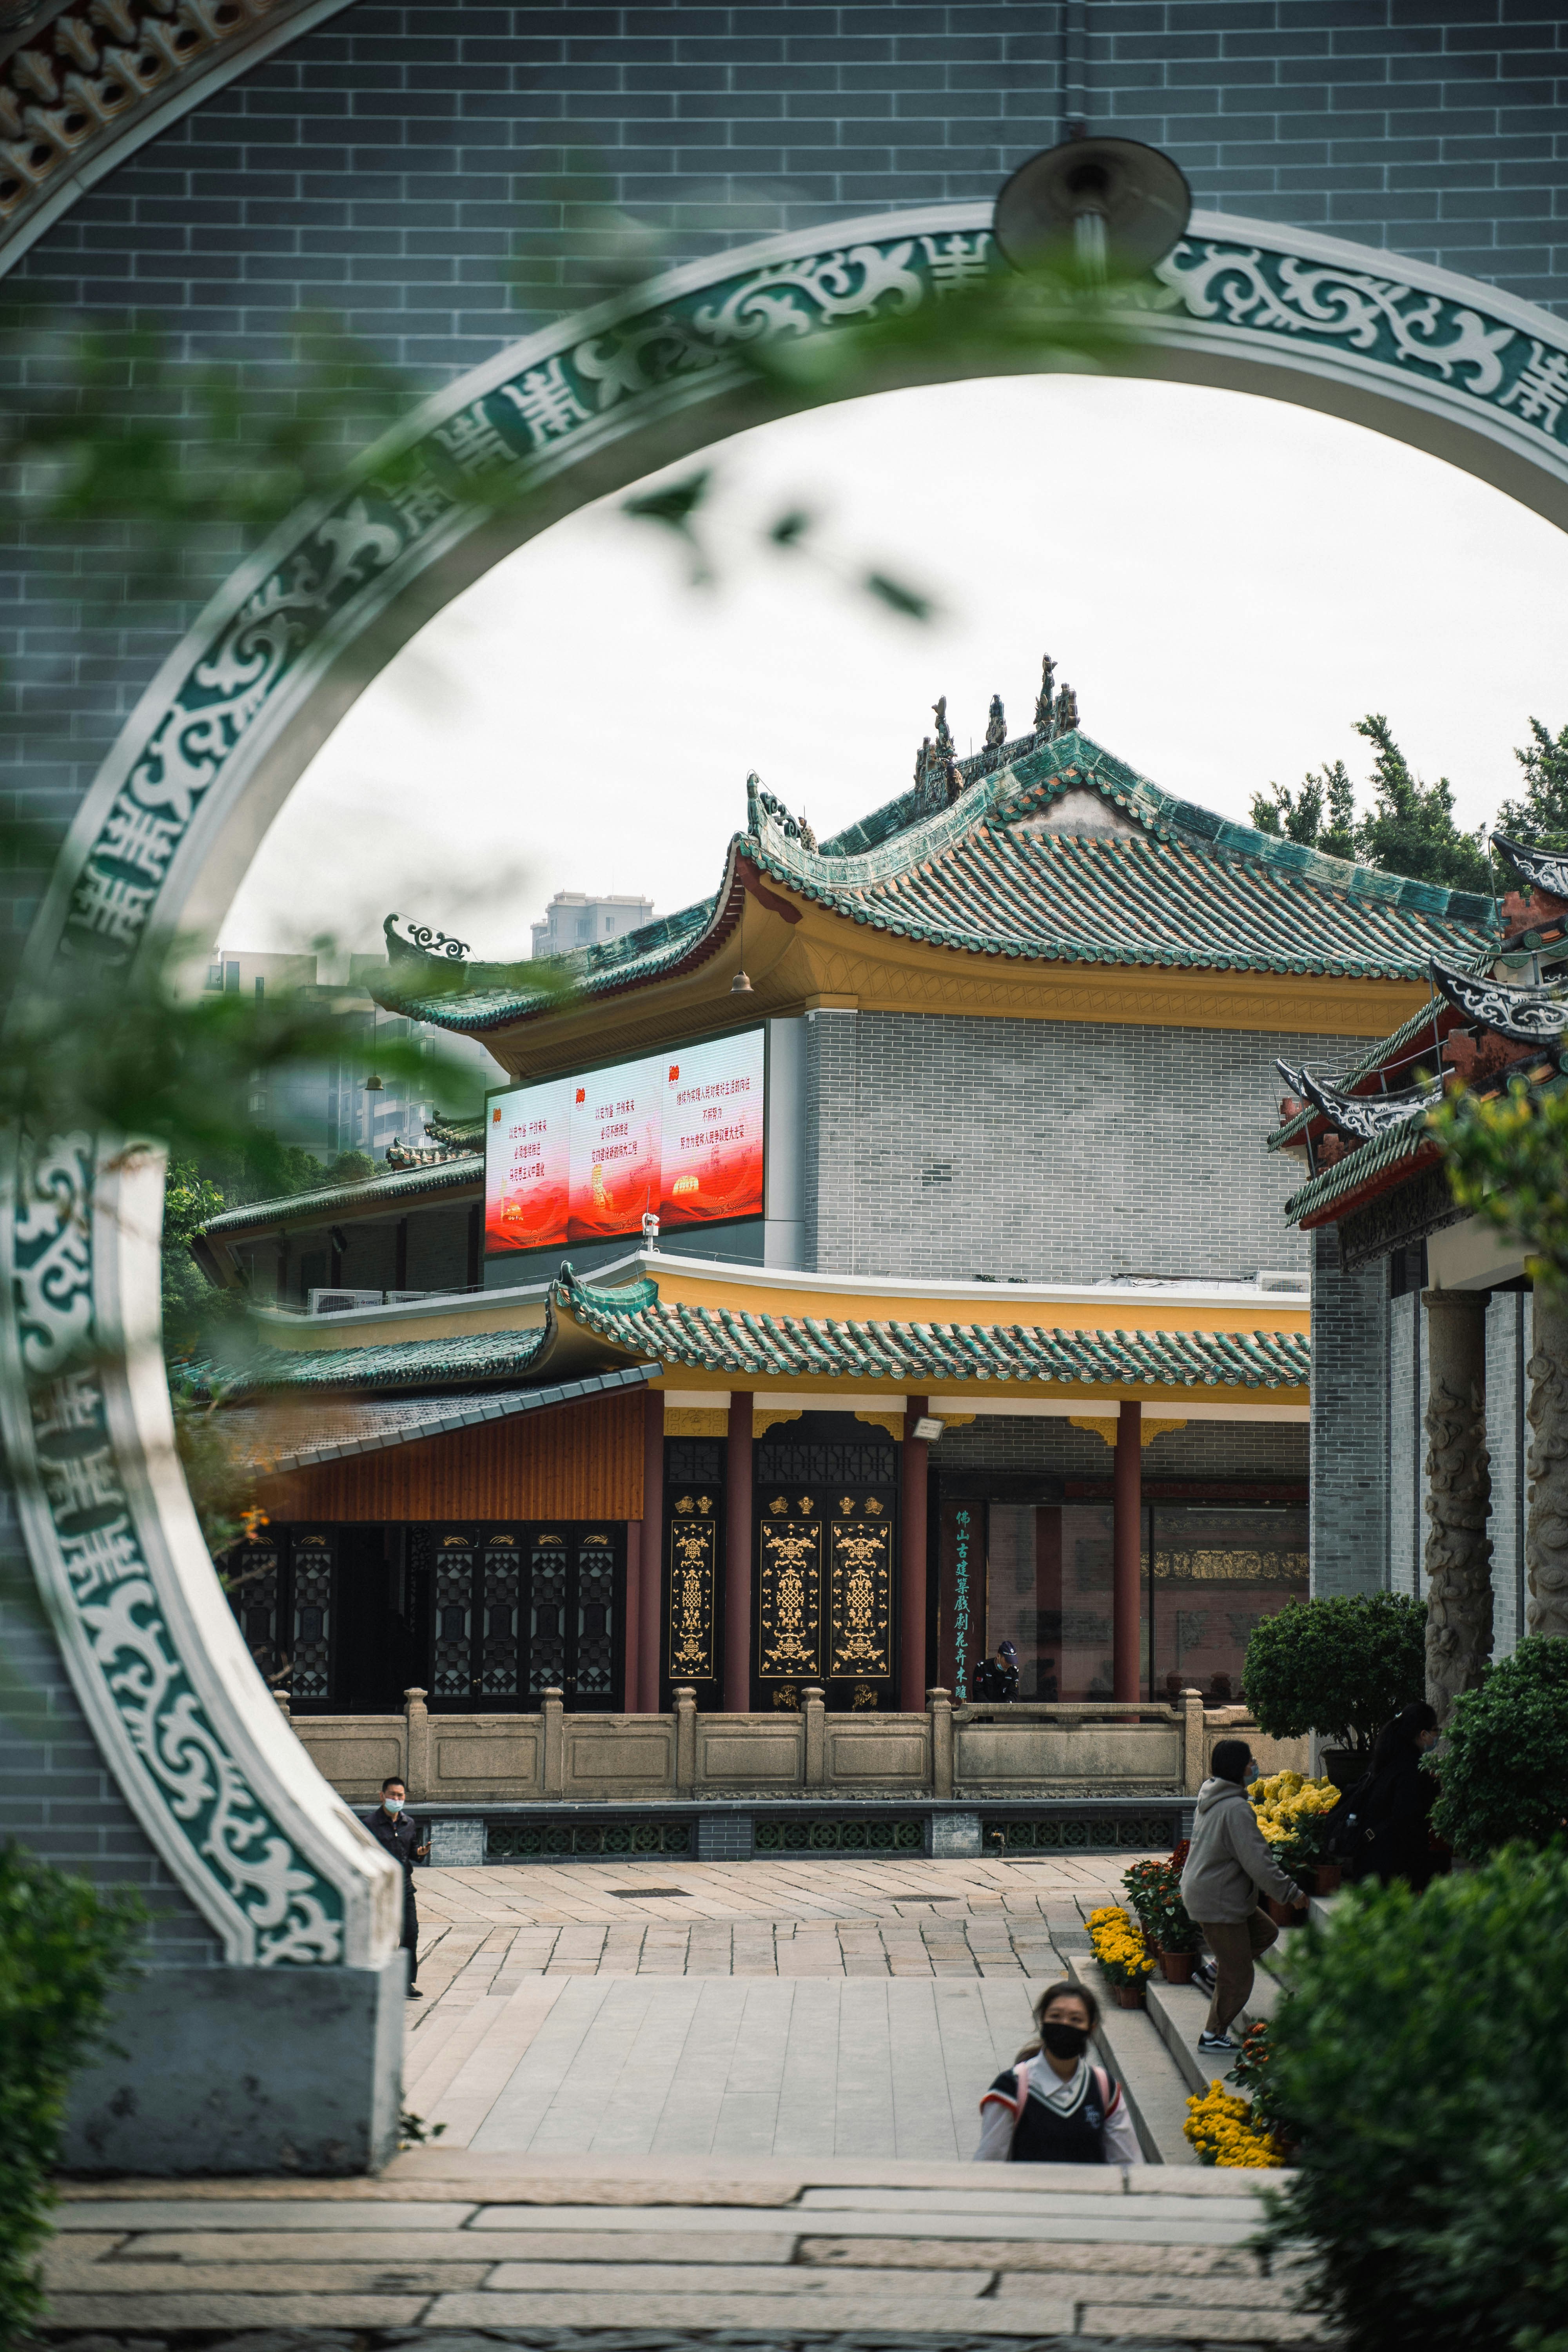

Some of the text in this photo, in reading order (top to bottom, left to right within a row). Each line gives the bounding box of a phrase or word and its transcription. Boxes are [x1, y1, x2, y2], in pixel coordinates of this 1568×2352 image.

[677, 1076, 750, 1105] 继续为实现人民对美好生活的向往
[595, 1103, 613, 1120] 以史为鉴
[616, 1099, 634, 1116] 开创未来
[702, 1106, 722, 1123] 不懈努力
[509, 1123, 526, 1139] 以史为鉴
[529, 1119, 546, 1135] 开创未来
[601, 1122, 628, 1140] 必须不断推进
[681, 1124, 744, 1150] 努力为党和人民争取更大光荣
[514, 1142, 541, 1160] 必须继续推进
[592, 1141, 637, 1163] 党的建设新的伟大工程
[509, 1162, 544, 1181] 马克思主义中国化
